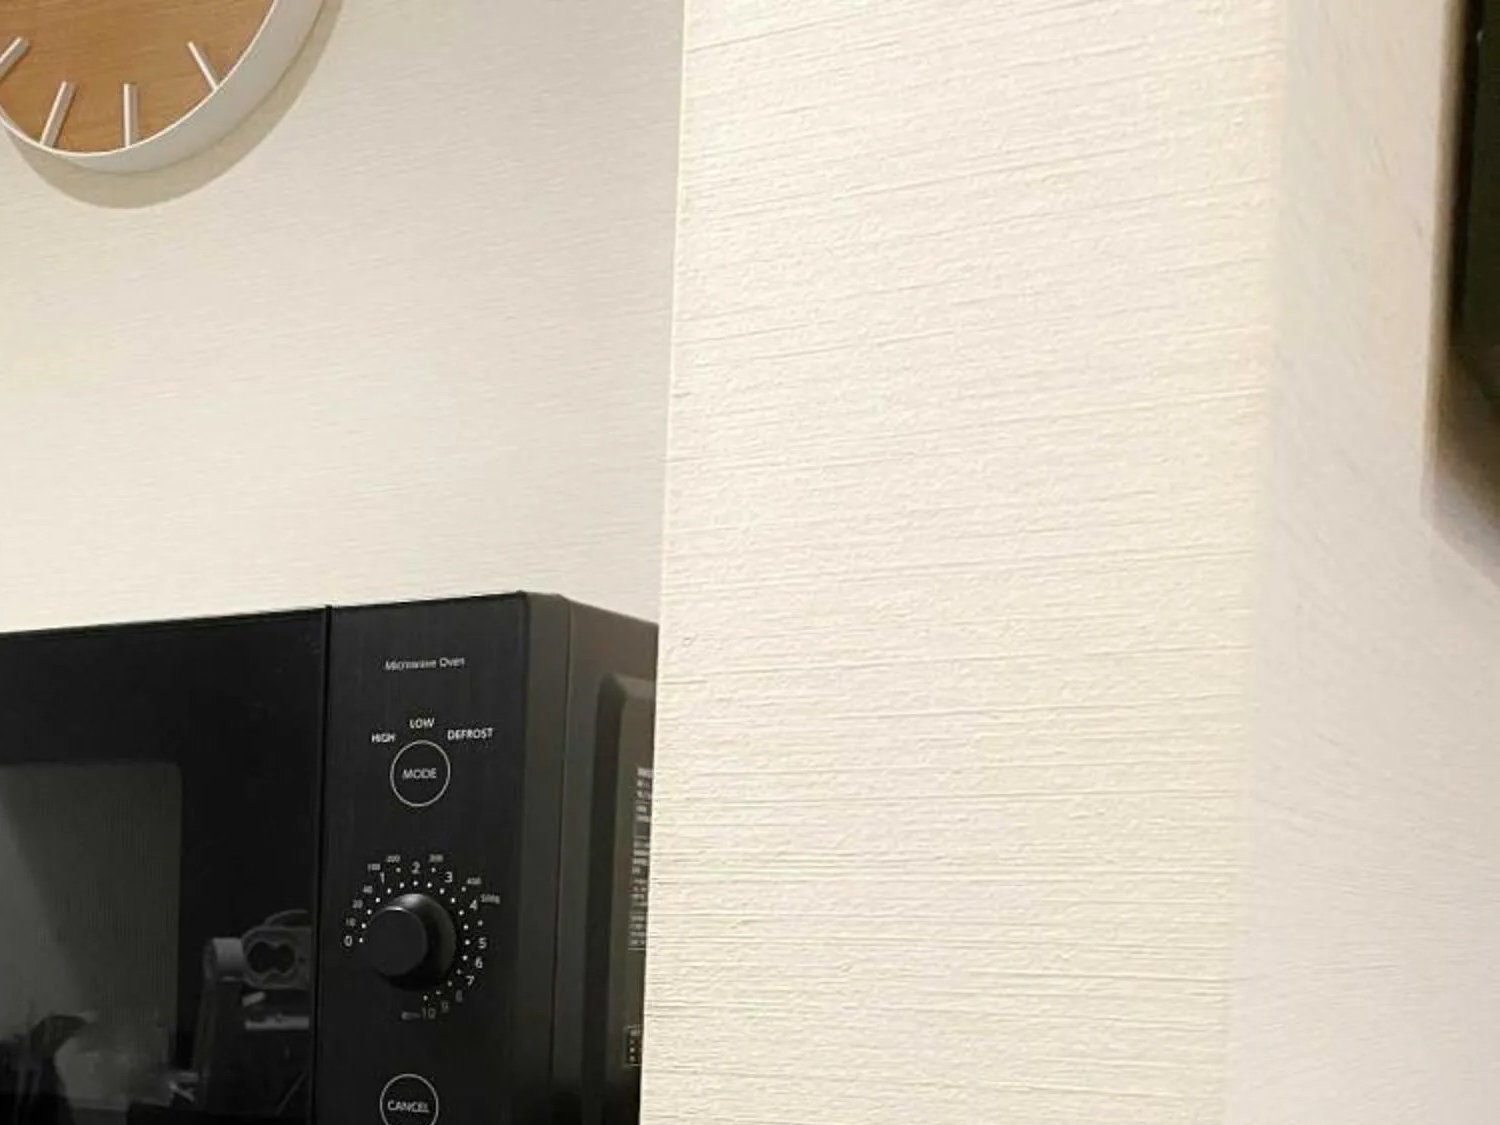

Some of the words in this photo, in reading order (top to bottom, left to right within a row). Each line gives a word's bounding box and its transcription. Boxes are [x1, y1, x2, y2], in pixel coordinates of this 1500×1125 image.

[409, 718, 435, 729] LOW
[371, 733, 396, 743] HIGH
[447, 728, 494, 740] DEFROST
[403, 768, 437, 779] MODE
[411, 861, 421, 875] 2
[444, 871, 453, 883] 3
[344, 935, 353, 947] 0
[479, 937, 487, 949] 5
[475, 957, 483, 969] 6
[466, 975, 475, 986] 7
[387, 1099, 430, 1113] CANCEL
